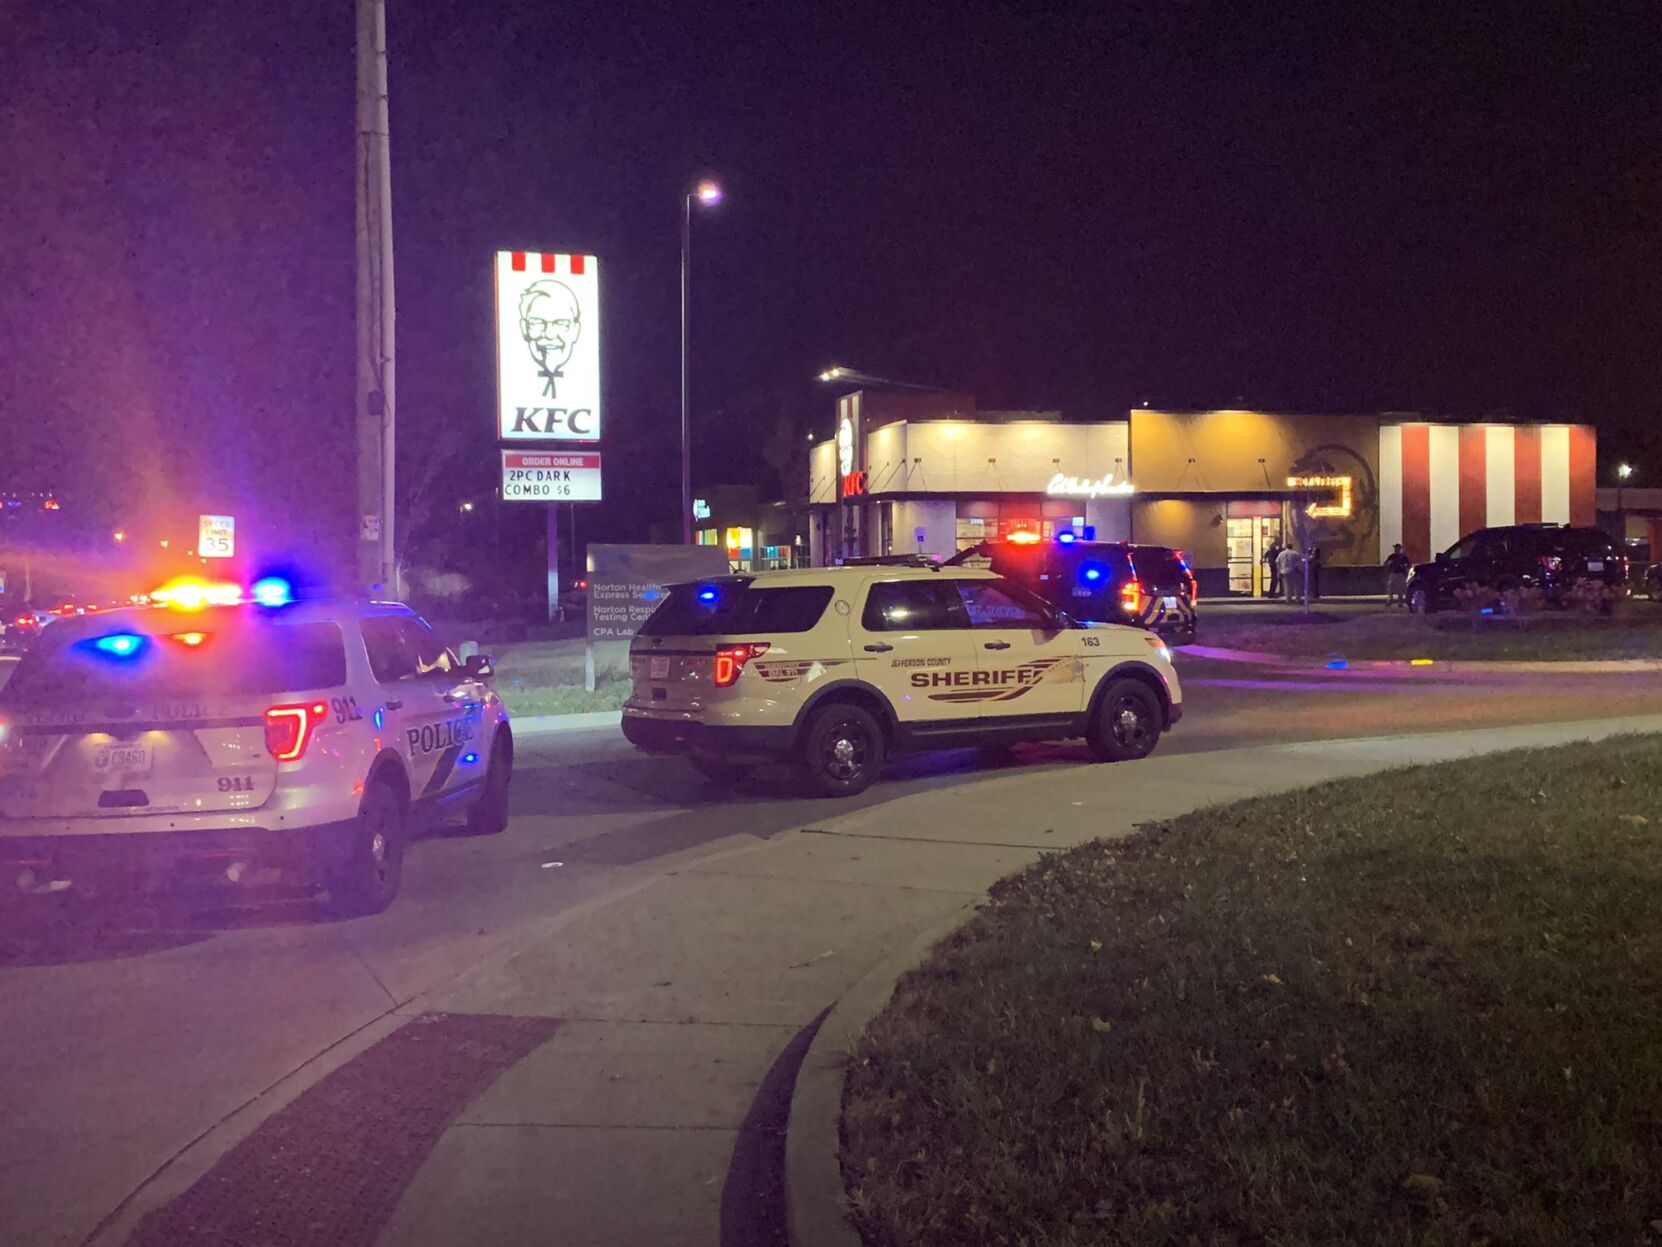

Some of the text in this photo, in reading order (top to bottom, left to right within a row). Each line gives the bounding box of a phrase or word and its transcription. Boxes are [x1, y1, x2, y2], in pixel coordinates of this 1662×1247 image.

[511, 407, 592, 435] KFC
[522, 457, 584, 467] ORDER ONLINE
[510, 470, 571, 481] 2PC DARK
[504, 484, 571, 496] COMBO $6
[843, 472, 863, 497] KFC
[206, 537, 229, 551] 35
[593, 591, 630, 601] Express
[593, 613, 628, 622] Testing
[1080, 636, 1100, 647] 163
[891, 656, 952, 668] JEFFERSON COUNTY
[911, 669, 1032, 688] SHERIFF
[332, 696, 363, 724] 911
[406, 719, 474, 757] POLICE
[217, 775, 255, 793] 911
